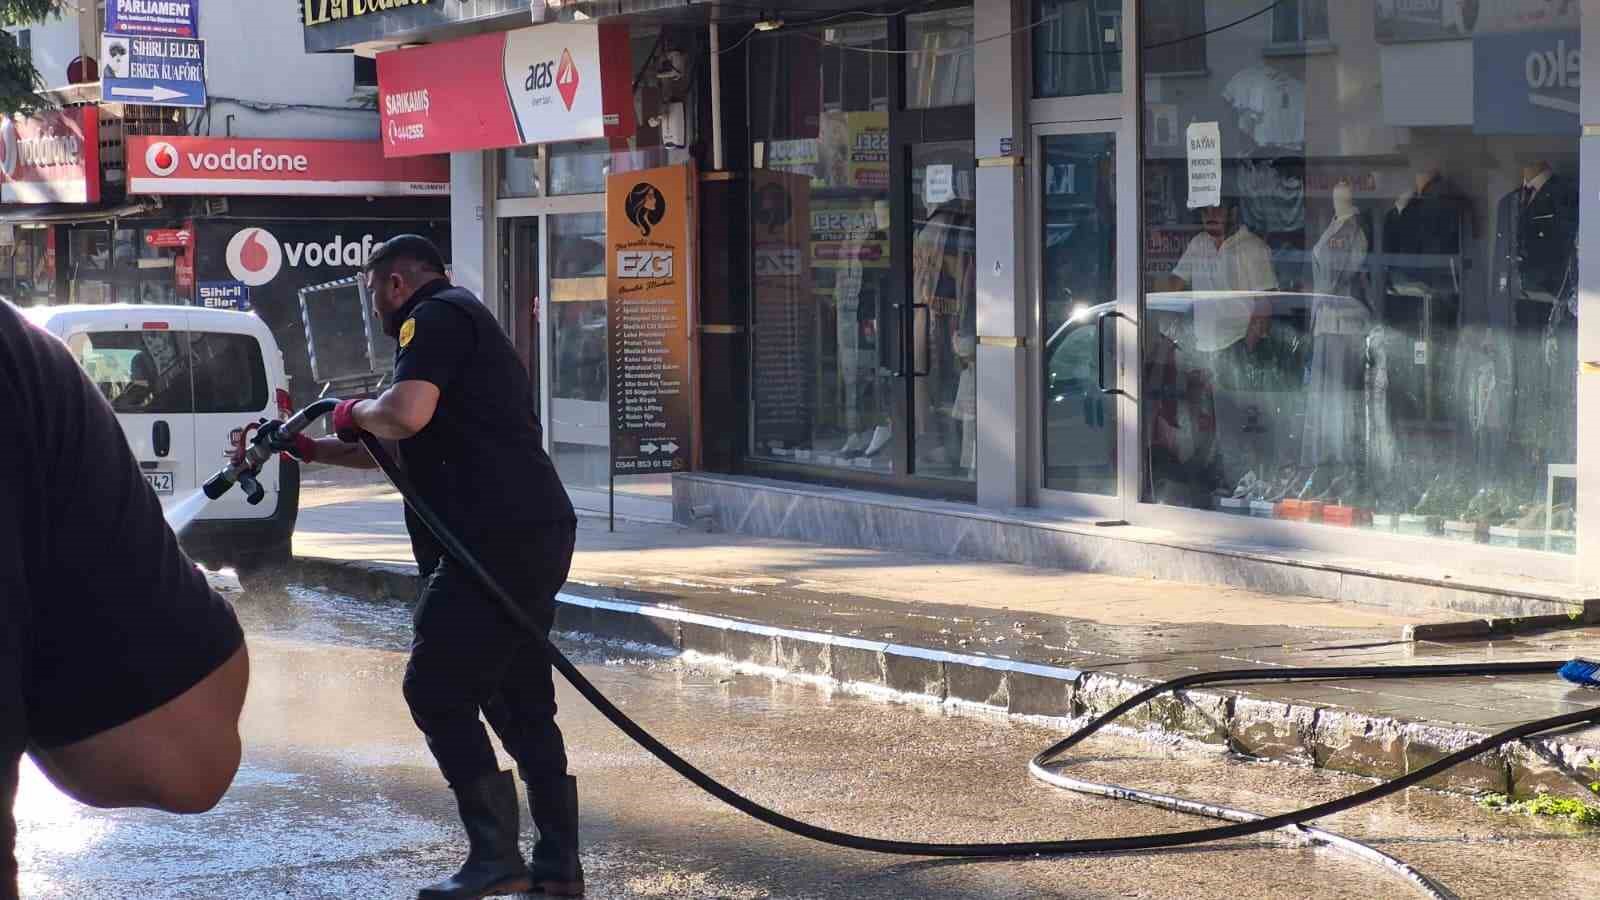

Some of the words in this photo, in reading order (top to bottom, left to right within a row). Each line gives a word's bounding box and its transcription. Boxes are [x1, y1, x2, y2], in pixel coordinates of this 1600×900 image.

[117, 0, 190, 16] PARLIAMENT
[170, 42, 200, 59] ELLER
[131, 62, 160, 79] ERKEK
[526, 61, 553, 91] aras
[187, 148, 308, 172] vodafone
[284, 234, 384, 267] vodaf
[204, 298, 236, 307] Eller
